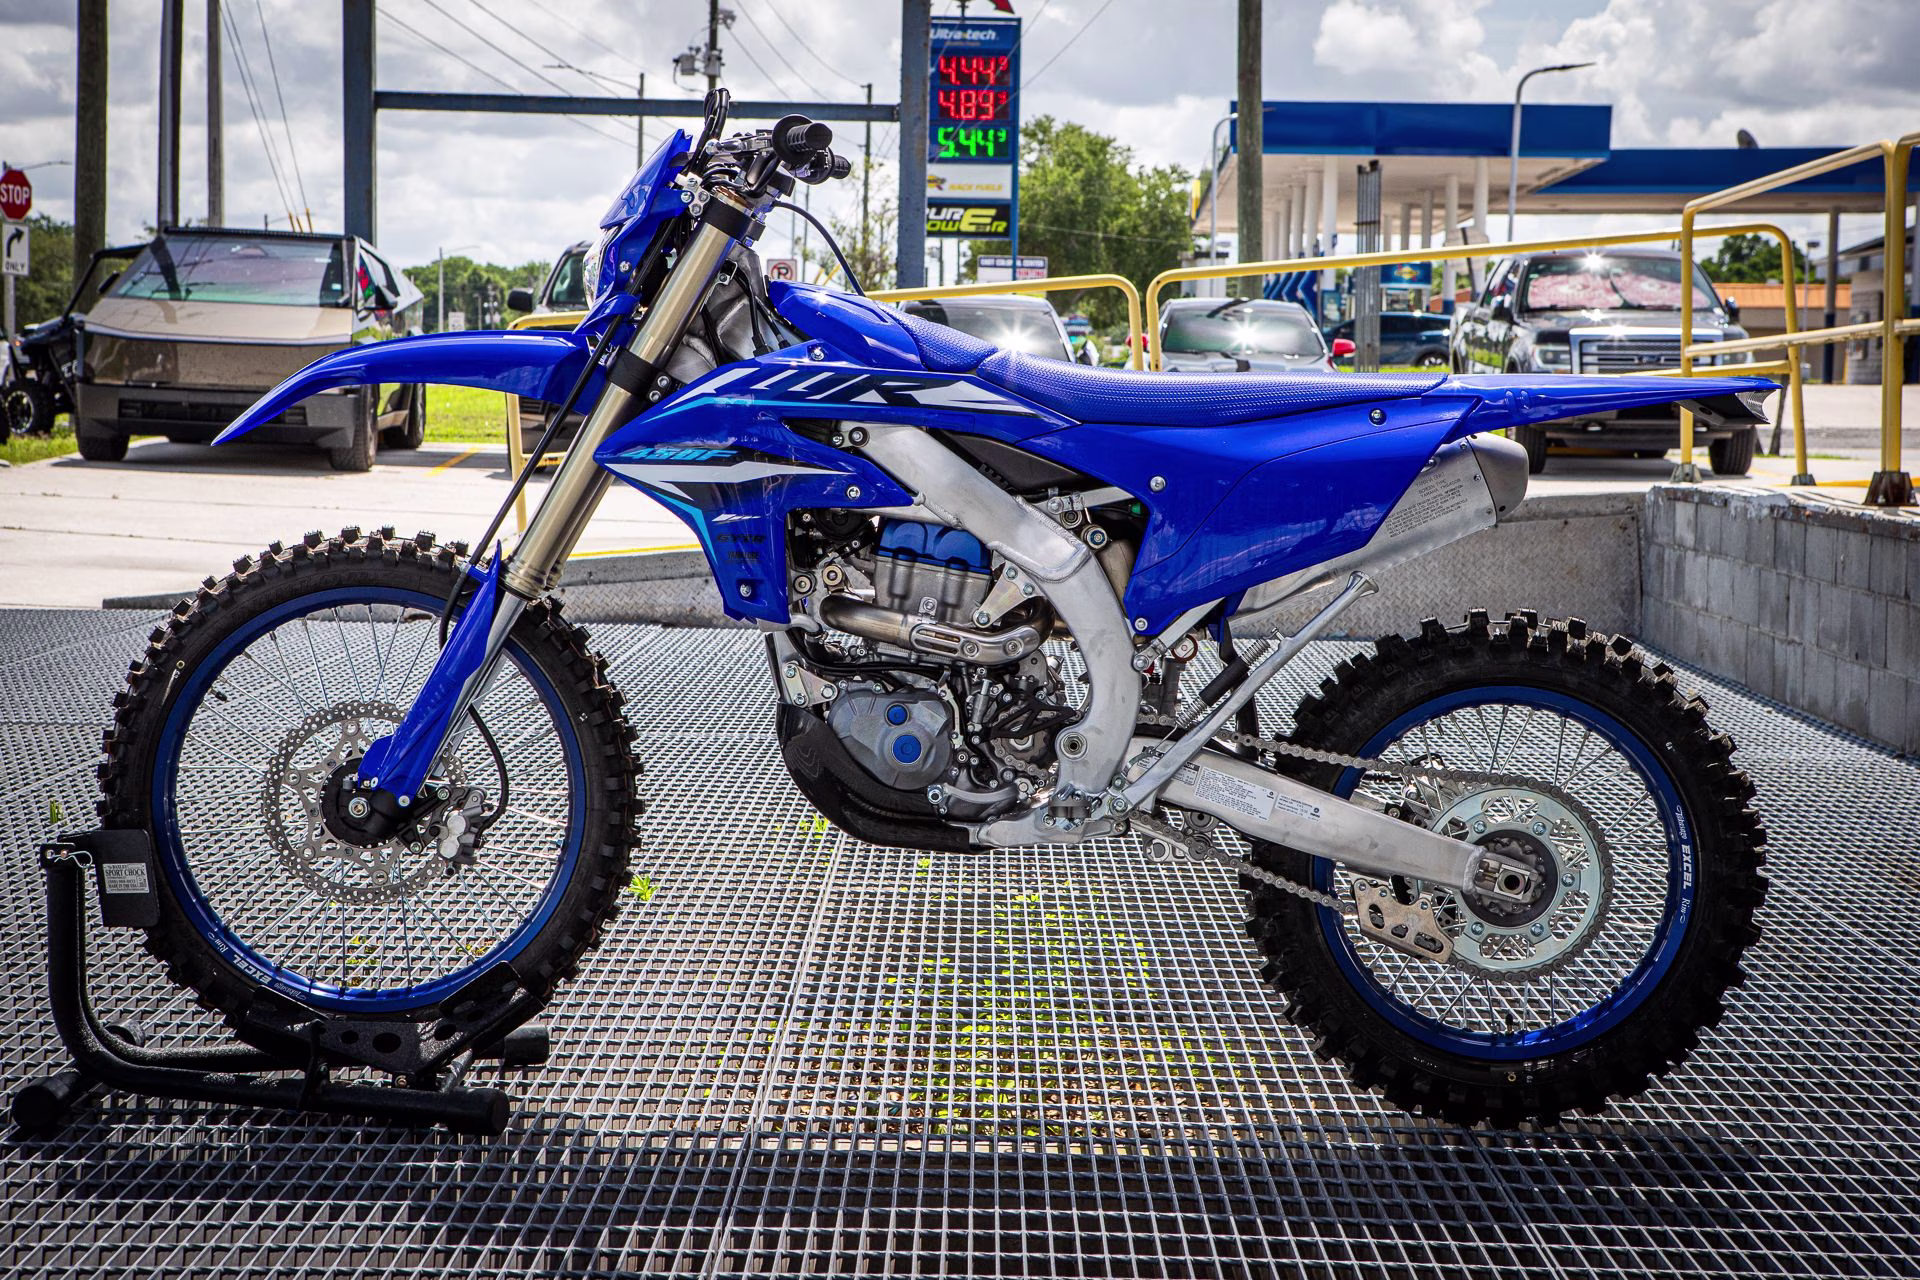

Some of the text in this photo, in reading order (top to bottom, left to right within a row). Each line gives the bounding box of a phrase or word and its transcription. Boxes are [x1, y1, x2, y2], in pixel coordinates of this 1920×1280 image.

[0, 183, 30, 205] STOP
[5, 261, 25, 272] ONLY
[619, 447, 739, 461] 450F
[124, 868, 145, 876] CHOCK
[1682, 844, 1692, 889] EXCEL
[233, 954, 272, 985] EXCEL
